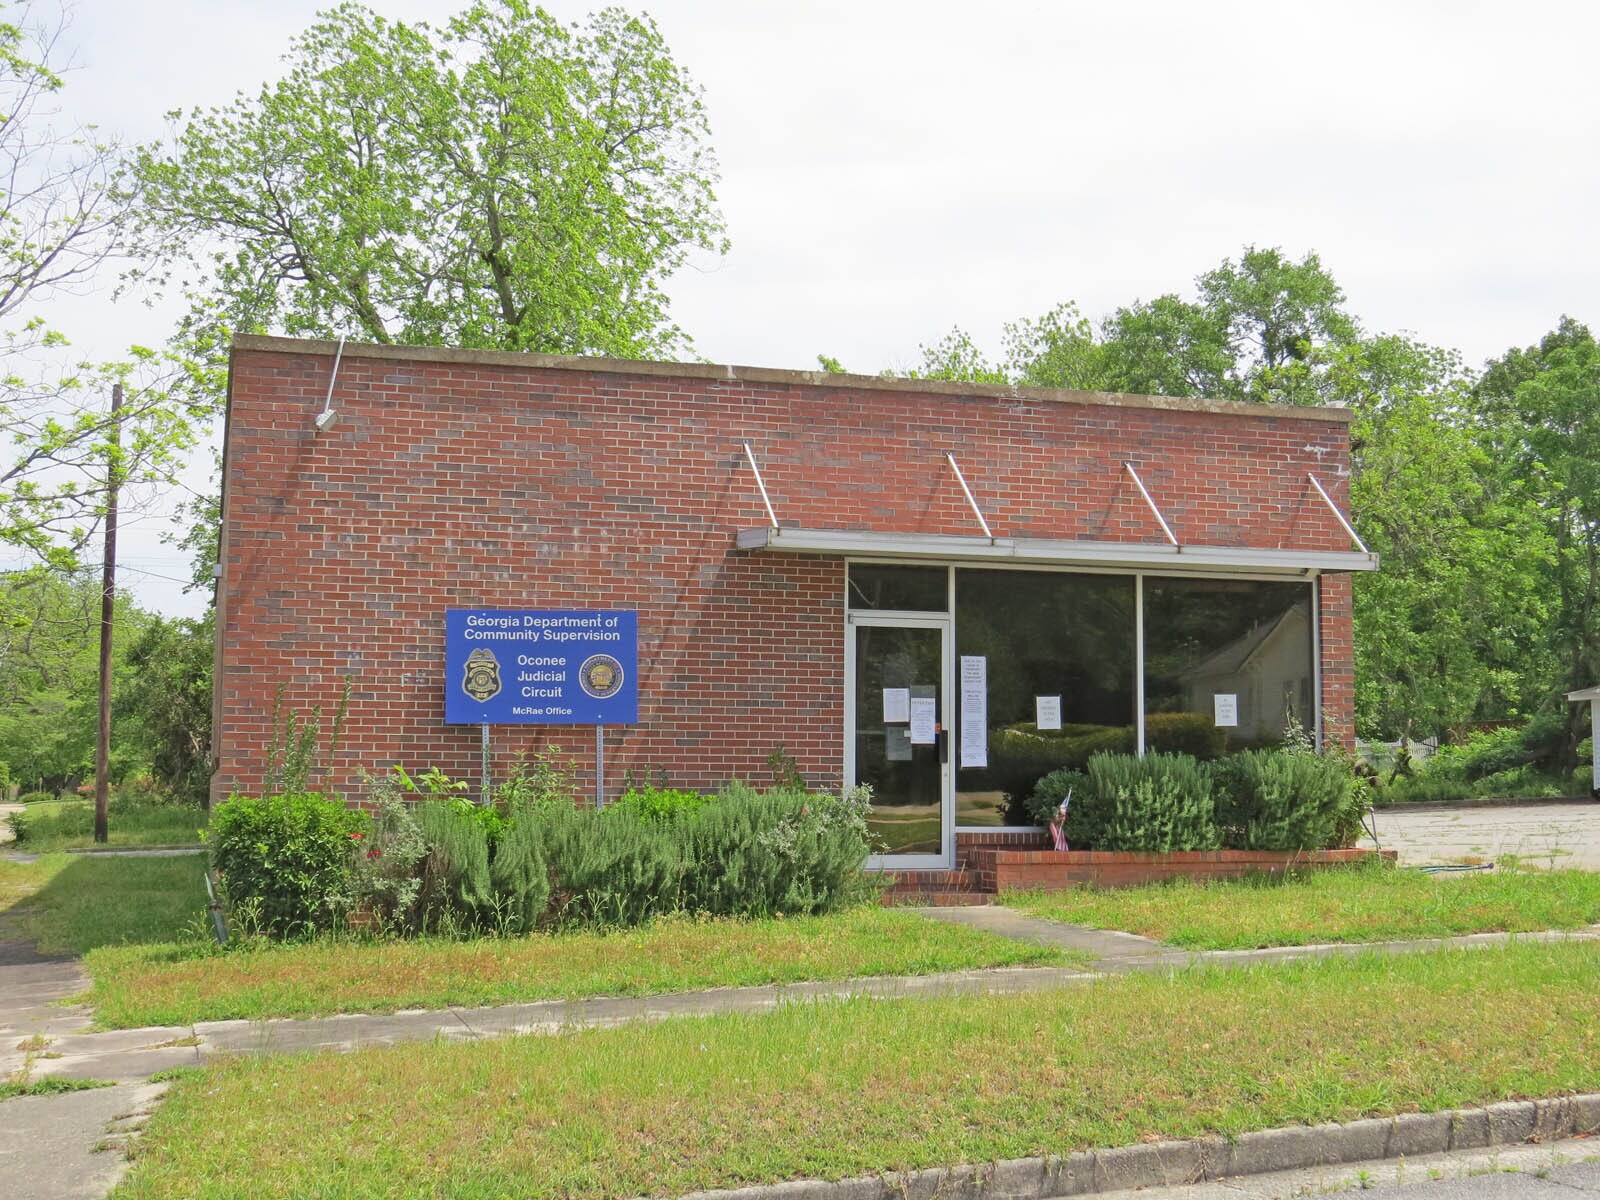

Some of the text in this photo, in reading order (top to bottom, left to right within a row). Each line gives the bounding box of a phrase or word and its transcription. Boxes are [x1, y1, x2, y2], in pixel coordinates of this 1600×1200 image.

[467, 616, 617, 629] Georgia Department of
[465, 629, 620, 642] Community Supervision
[518, 655, 566, 665] Oconee
[518, 671, 565, 681] Judicial
[521, 687, 562, 697] Circuit
[513, 707, 572, 715] McRae Office
